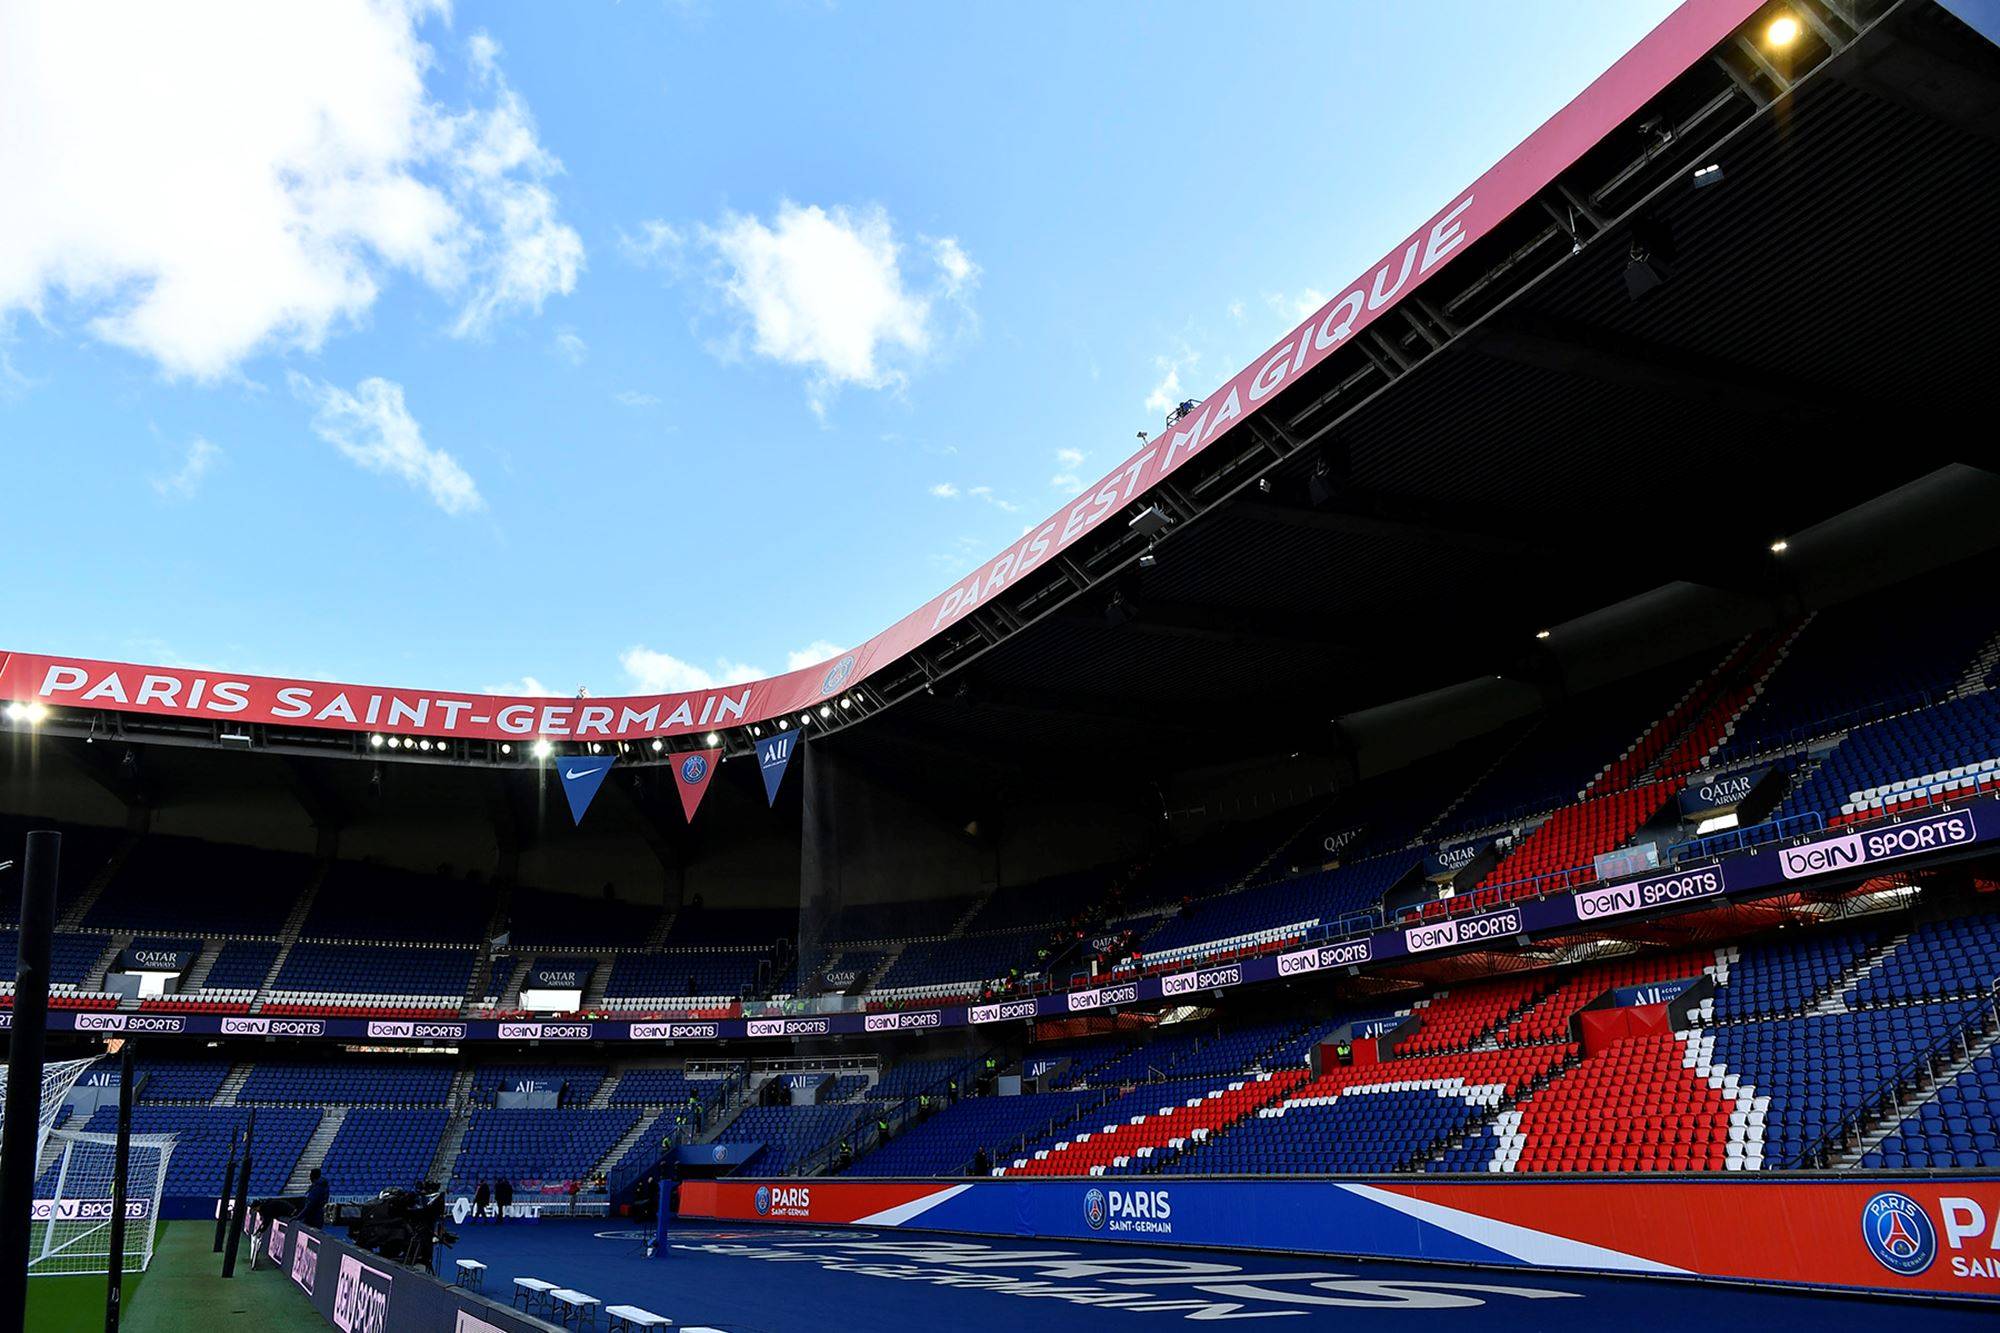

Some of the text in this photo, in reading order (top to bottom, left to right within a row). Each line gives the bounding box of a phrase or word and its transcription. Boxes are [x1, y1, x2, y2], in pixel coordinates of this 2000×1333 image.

[932, 193, 1475, 631] PARIS EST MAGIQUE
[39, 665, 752, 735] PARIS SAINT-GERMAIN
[1700, 776, 1751, 801] QATAR
[1868, 818, 1966, 858] SPORTS
[1438, 846, 1475, 865] QATAR
[1643, 873, 1717, 903] SPORTS
[1460, 914, 1517, 939] SPORTS
[135, 950, 177, 963] QATAR
[1320, 944, 1367, 965] SPORTS
[539, 971, 576, 983] QATAR
[1199, 968, 1239, 987] SPORTS
[1101, 987, 1135, 1002] SPORTS
[1001, 1002, 1035, 1016] SPORTS
[128, 1018, 181, 1031] SPORTS
[271, 1021, 321, 1034] SPORTS
[786, 1020, 826, 1033] SPORTS
[900, 1013, 938, 1027] SPORTS
[415, 1025, 462, 1037] SPORTS
[543, 1026, 588, 1037] SPORTS
[672, 1026, 714, 1037] SPORTS
[772, 1188, 810, 1207] PARIS
[1108, 1190, 1171, 1219] PARIS
[81, 1203, 142, 1216] SPOTS
[1871, 1197, 1917, 1218] PARIS
[1939, 1197, 2000, 1249] P
